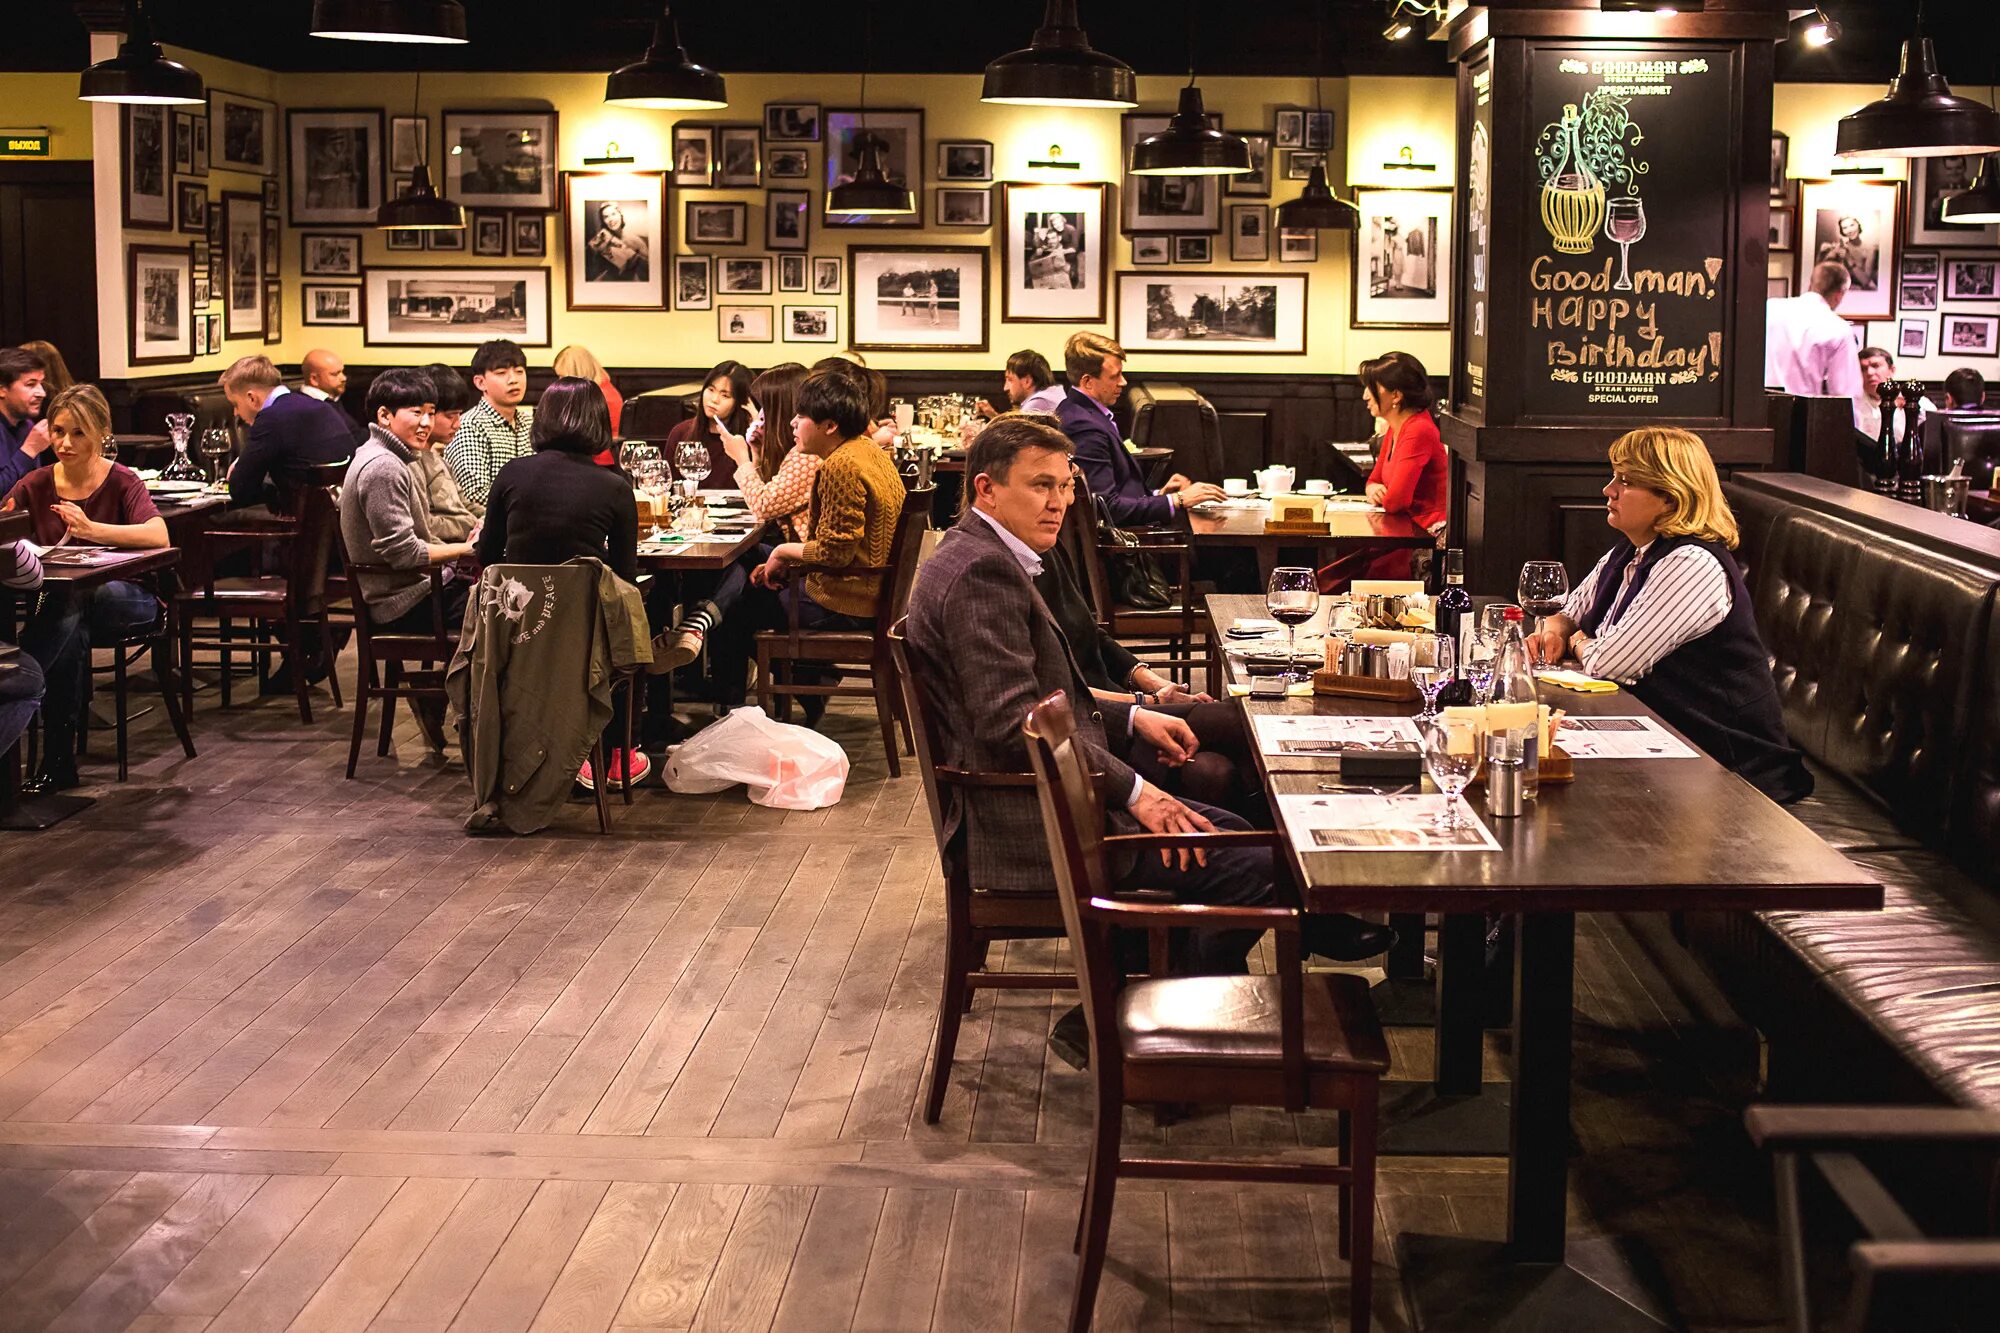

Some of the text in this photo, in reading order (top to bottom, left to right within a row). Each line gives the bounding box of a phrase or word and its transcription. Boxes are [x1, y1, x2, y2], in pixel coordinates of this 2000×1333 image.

[1592, 61, 1677, 74] GOODMAN
[8, 140, 41, 150] ВЫХОД
[1530, 255, 1613, 292] Good
[1547, 331, 1722, 382] Birthday!
[1582, 371, 1666, 385] GOODMAN
[1588, 394, 1659, 404] SPECIAL OFFER
